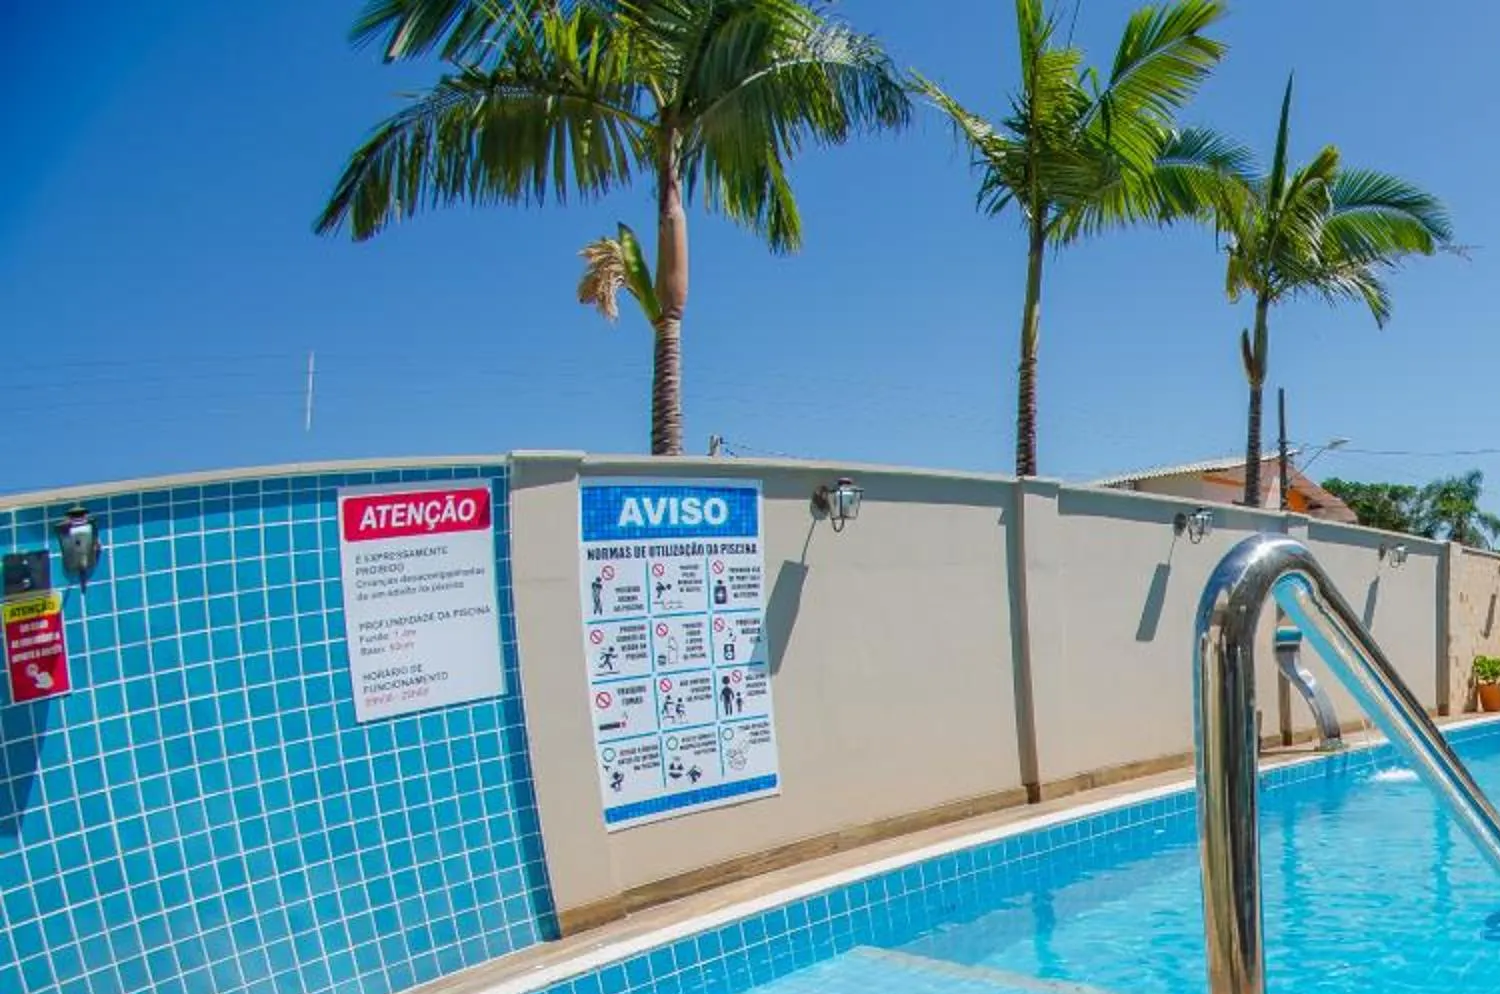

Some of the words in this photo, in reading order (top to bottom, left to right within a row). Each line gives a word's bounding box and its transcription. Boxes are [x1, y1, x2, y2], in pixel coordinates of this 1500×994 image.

[359, 495, 477, 531] ATENÇÃO
[618, 496, 729, 527] AVISO
[587, 545, 632, 560] NORMAS
[634, 545, 646, 559] DE
[650, 541, 704, 558] UTILIZAÇÃO
[706, 544, 719, 555] DA
[720, 543, 757, 555] PISCINA
